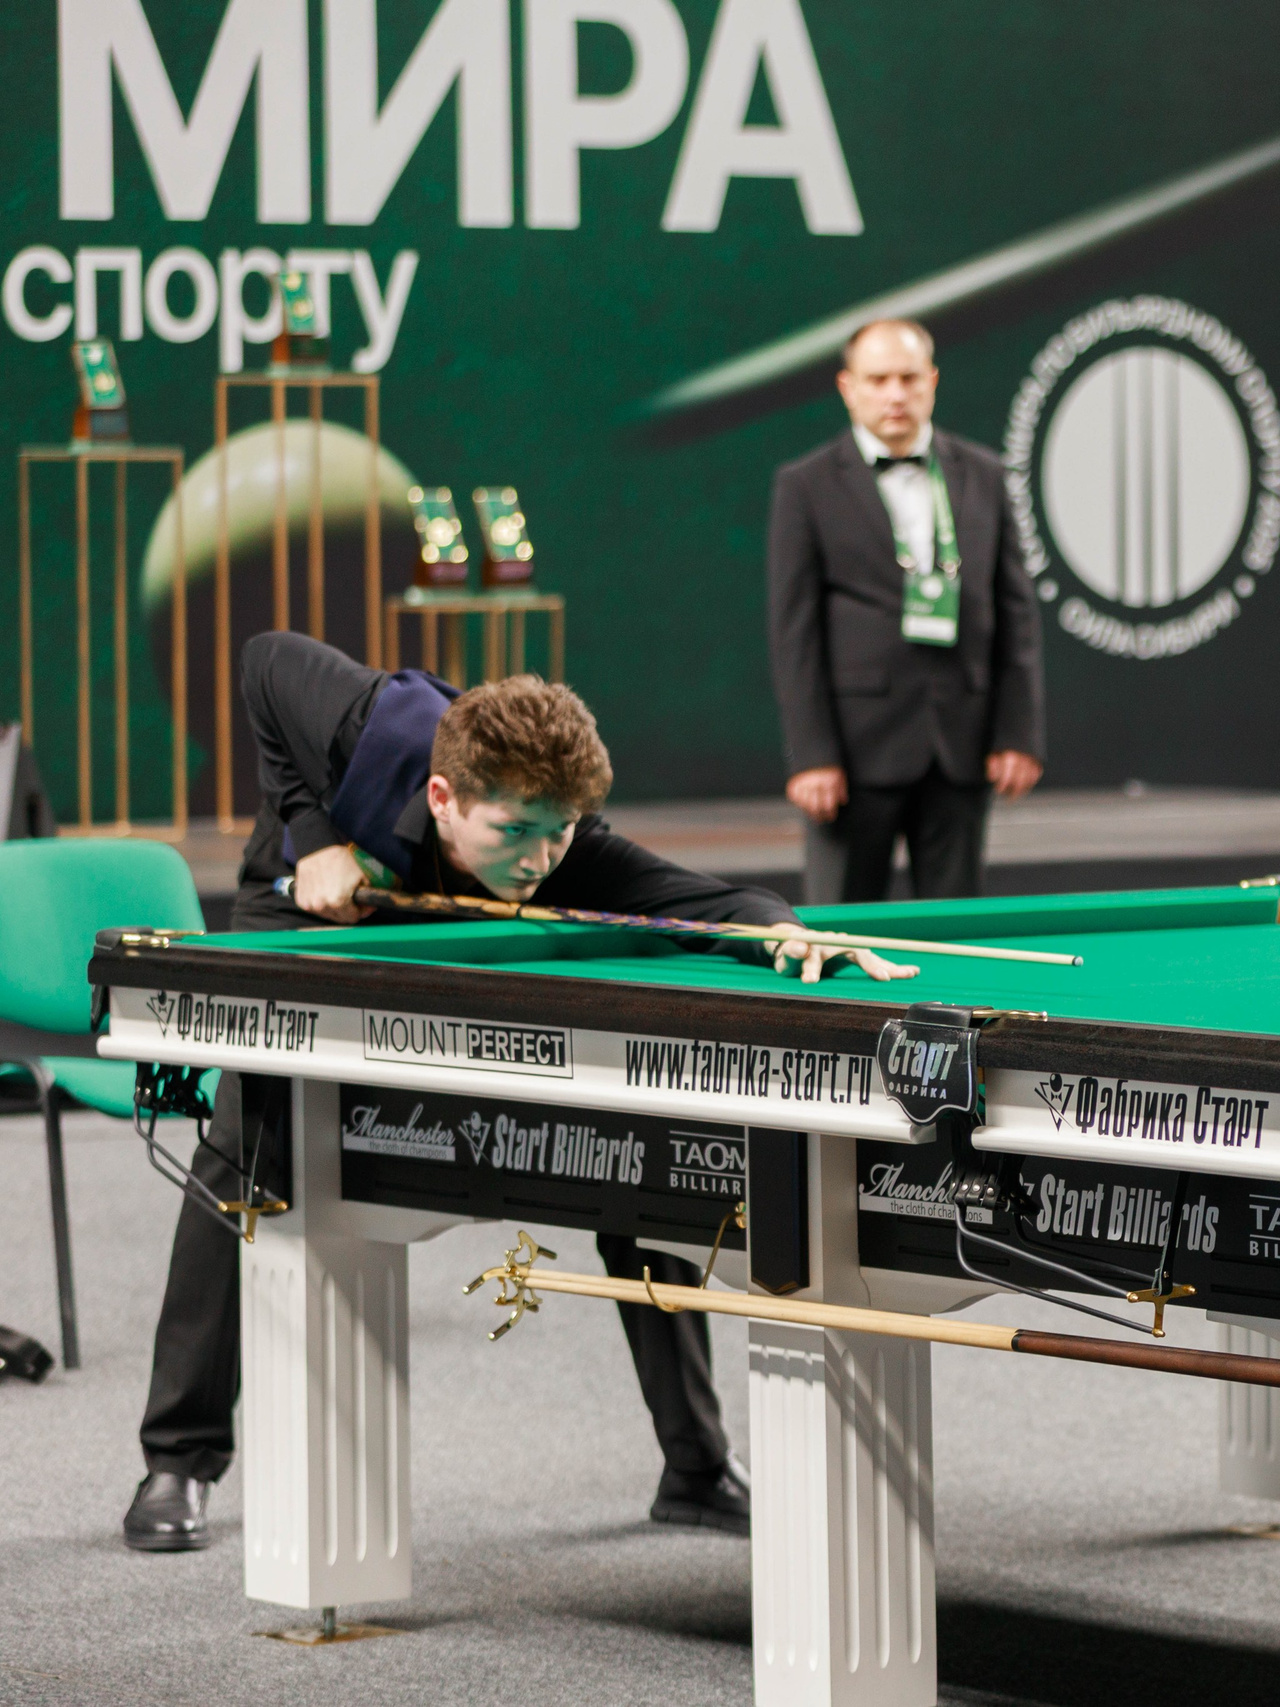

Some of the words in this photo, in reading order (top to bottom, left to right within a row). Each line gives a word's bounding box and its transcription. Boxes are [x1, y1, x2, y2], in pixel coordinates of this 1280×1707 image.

[58, 0, 864, 235] МИРА
[2, 245, 419, 374] спорту
[177, 993, 259, 1047] Фабрика
[264, 1001, 319, 1052] Старт
[369, 1016, 462, 1058] MOUNT
[468, 1028, 566, 1066] PERFECT
[625, 1039, 873, 1106] www.fabrika-start.ru
[888, 1030, 959, 1085] Старт
[889, 1081, 947, 1100] ФАБРИКА
[1076, 1077, 1186, 1143] Фабрика
[1193, 1086, 1269, 1149] Старт
[343, 1103, 456, 1146] Manchester
[492, 1113, 549, 1172] Start
[551, 1123, 645, 1185] Billiards
[669, 1173, 742, 1195] BILLIAR
[859, 1161, 953, 1204] Manch
[890, 1201, 903, 1213] the
[906, 1202, 925, 1216] cloth
[927, 1203, 936, 1216] of
[1037, 1174, 1104, 1238] Start
